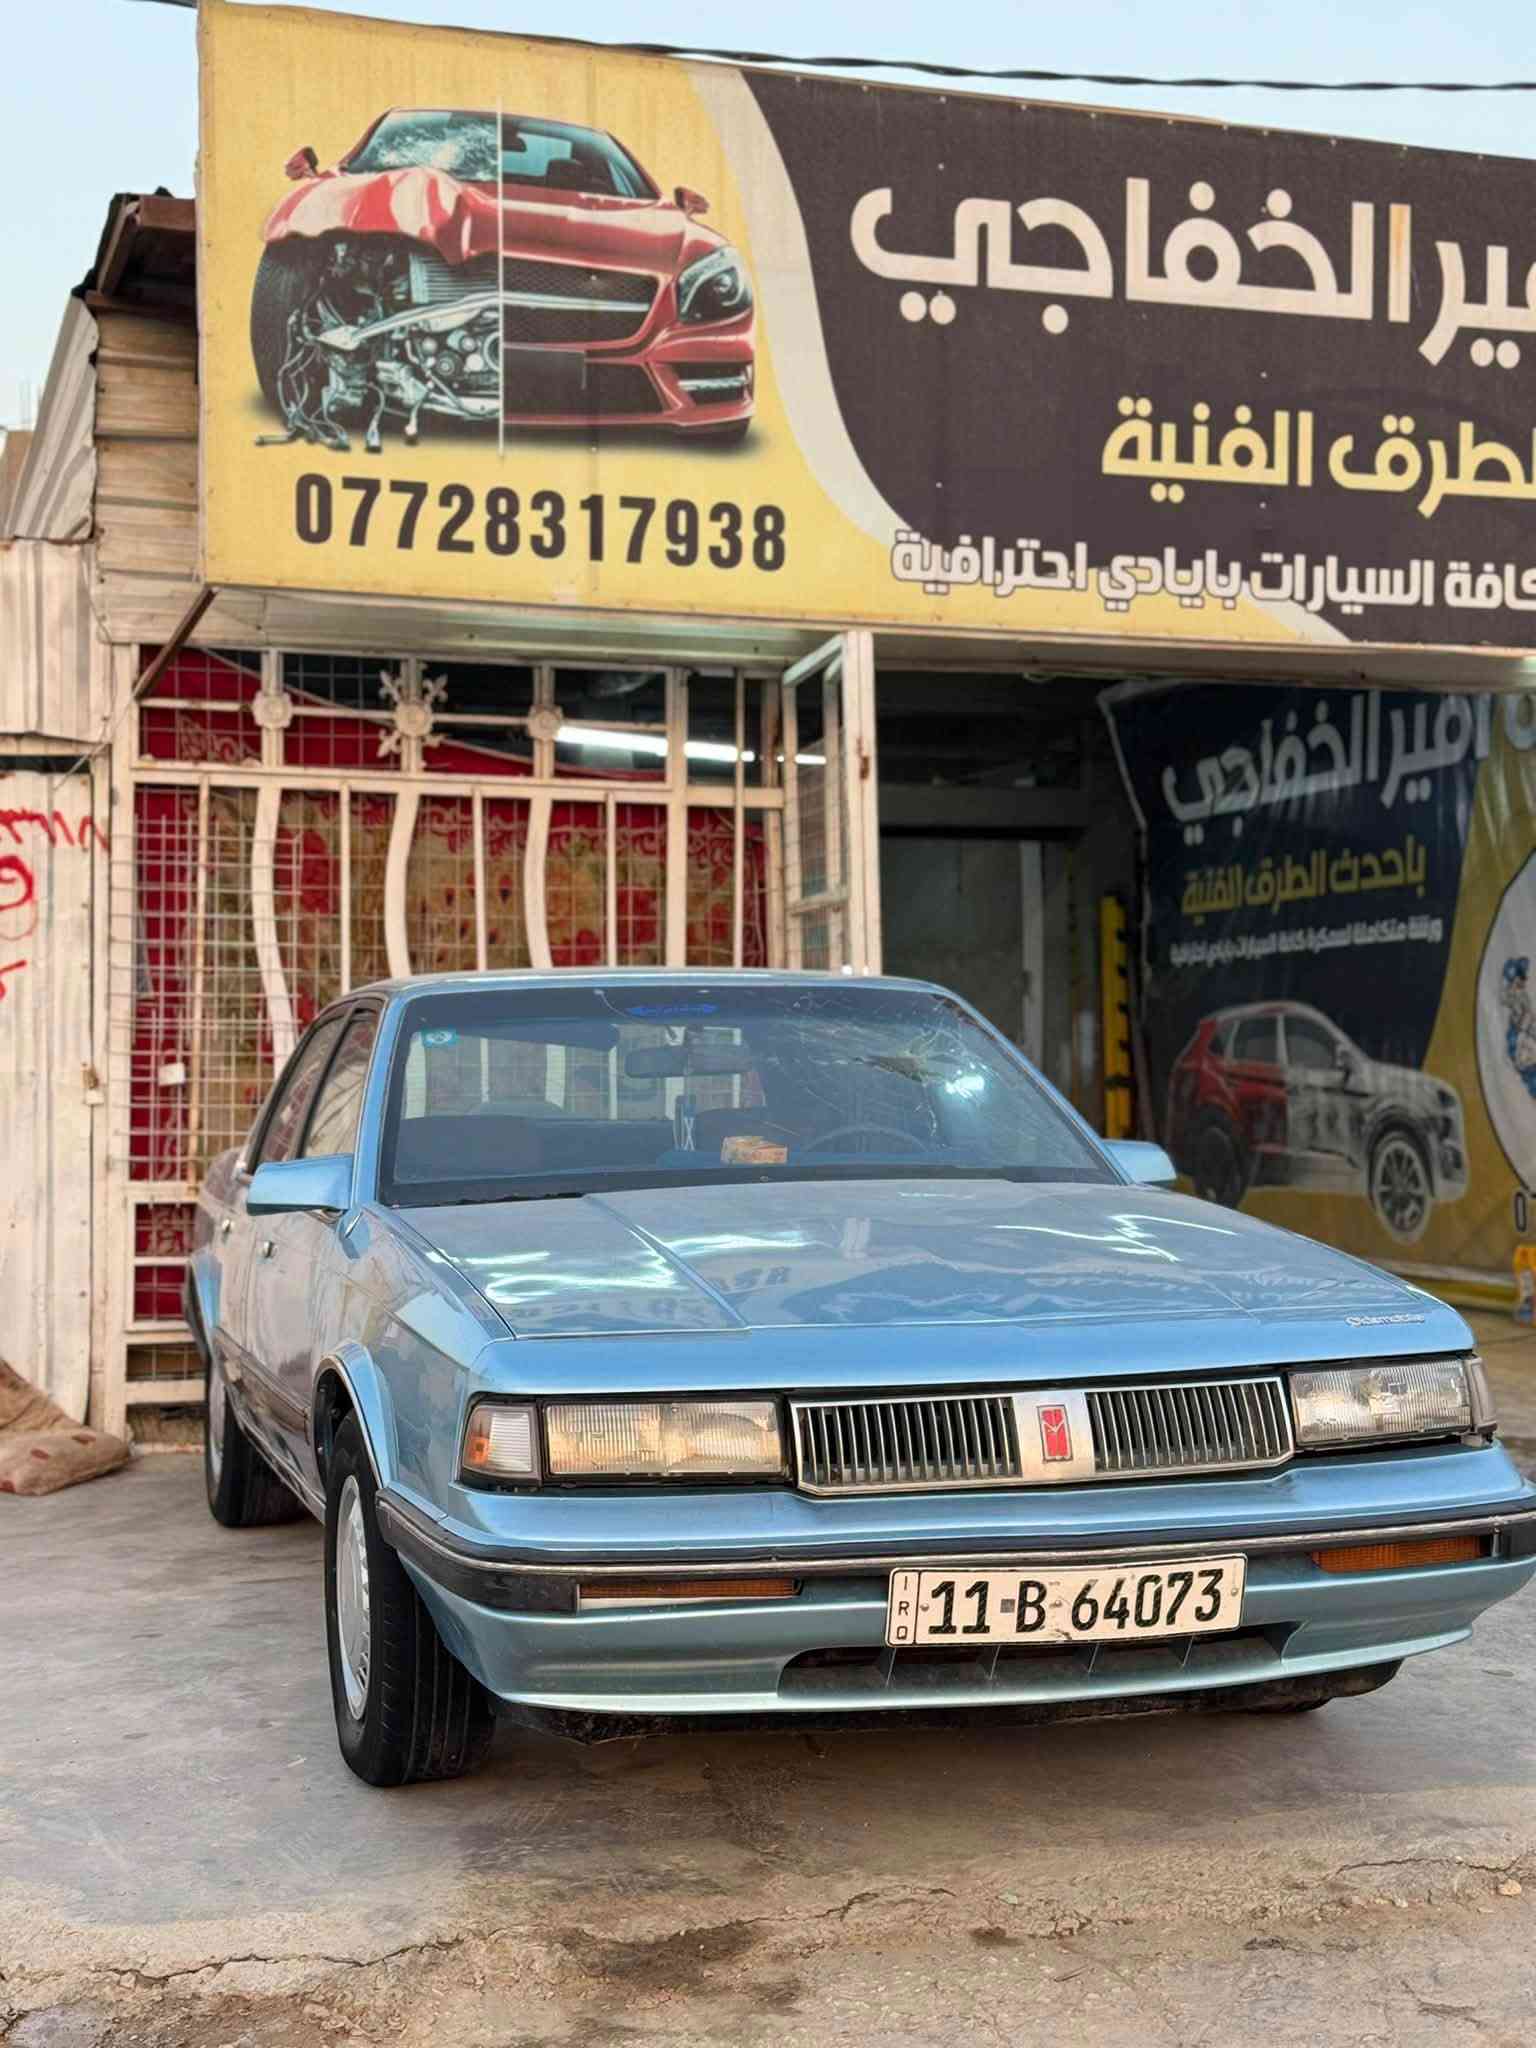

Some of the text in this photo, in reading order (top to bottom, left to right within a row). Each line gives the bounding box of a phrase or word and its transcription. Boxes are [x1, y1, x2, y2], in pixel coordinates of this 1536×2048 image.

[850, 177, 1536, 370] ير الخفاجي
[1102, 396, 1536, 518] طرق الفنية
[295, 473, 785, 571] 07728317938
[891, 530, 1088, 597] احترافية
[1098, 546, 1241, 612] بايادي
[1250, 553, 1434, 614] السيارات
[1161, 689, 1381, 845] الخفاجي
[928, 1567, 1225, 1635] 11 B 64073
